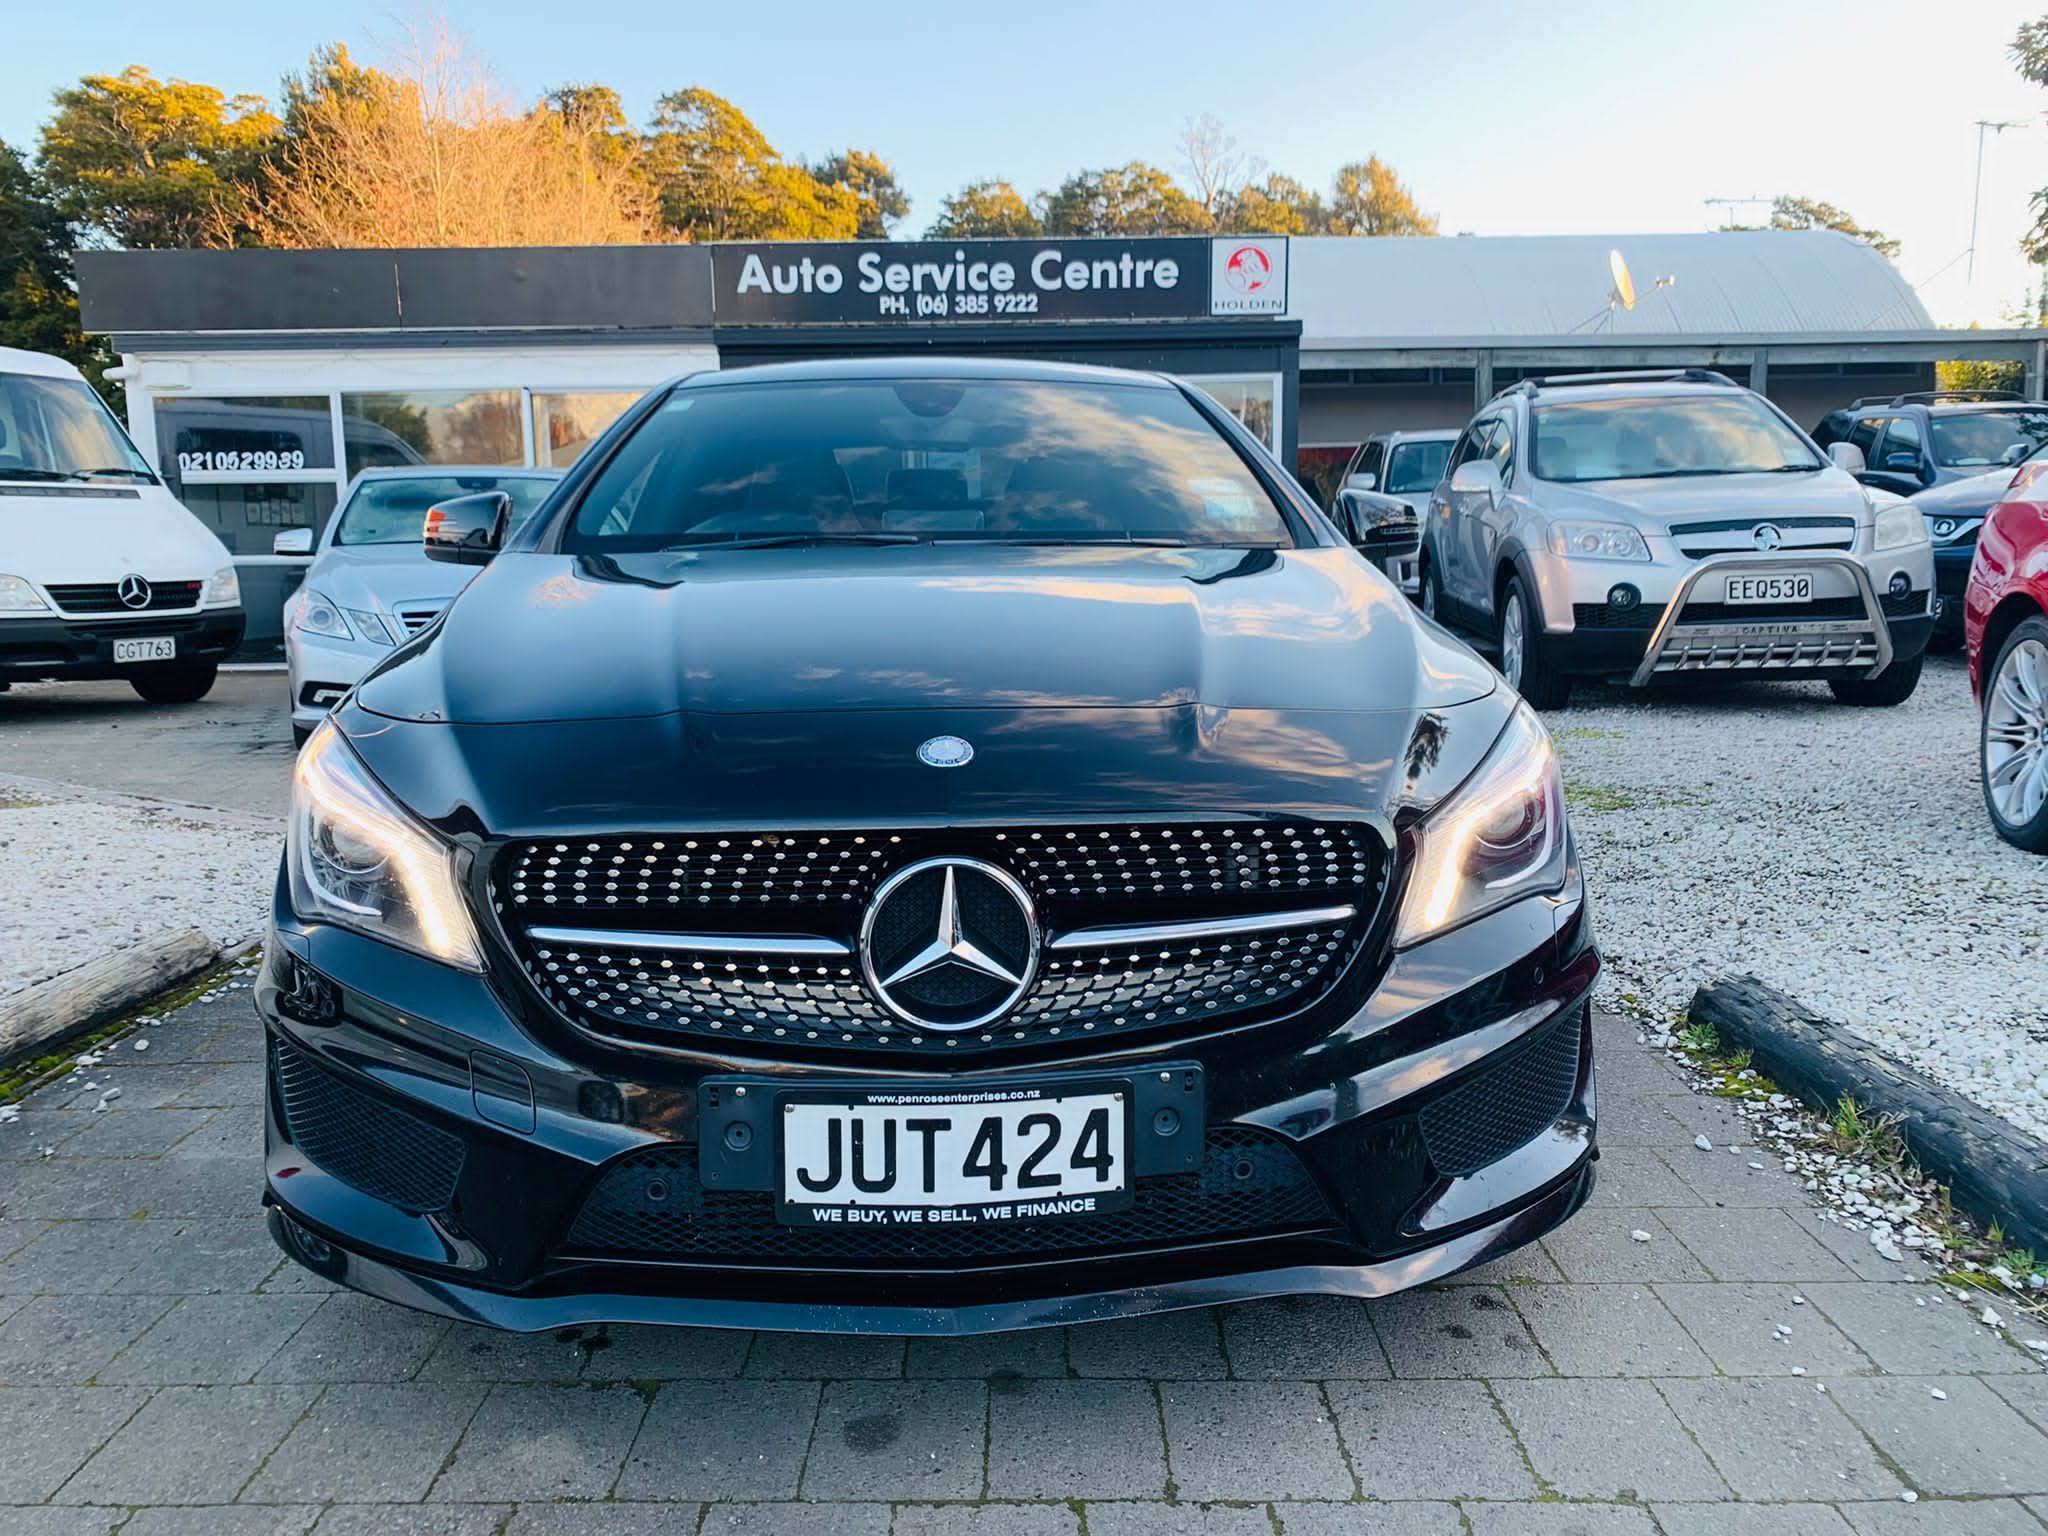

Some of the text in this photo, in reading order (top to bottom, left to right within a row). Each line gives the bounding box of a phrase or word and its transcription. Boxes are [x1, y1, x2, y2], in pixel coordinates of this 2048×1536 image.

[737, 249, 1179, 294] Auto Service Centre
[879, 293, 1038, 316] PH. (06) 385 9222
[1214, 300, 1282, 310] HOLDEN
[1728, 578, 1810, 600] EEQ530
[116, 640, 172, 659] CGT763
[867, 1089, 1041, 1104] www.penroseenterprises.co.nz
[796, 1108, 1114, 1193] JUT424
[812, 1198, 1096, 1225] WE BUY, WE SELL, WE FINANCE
